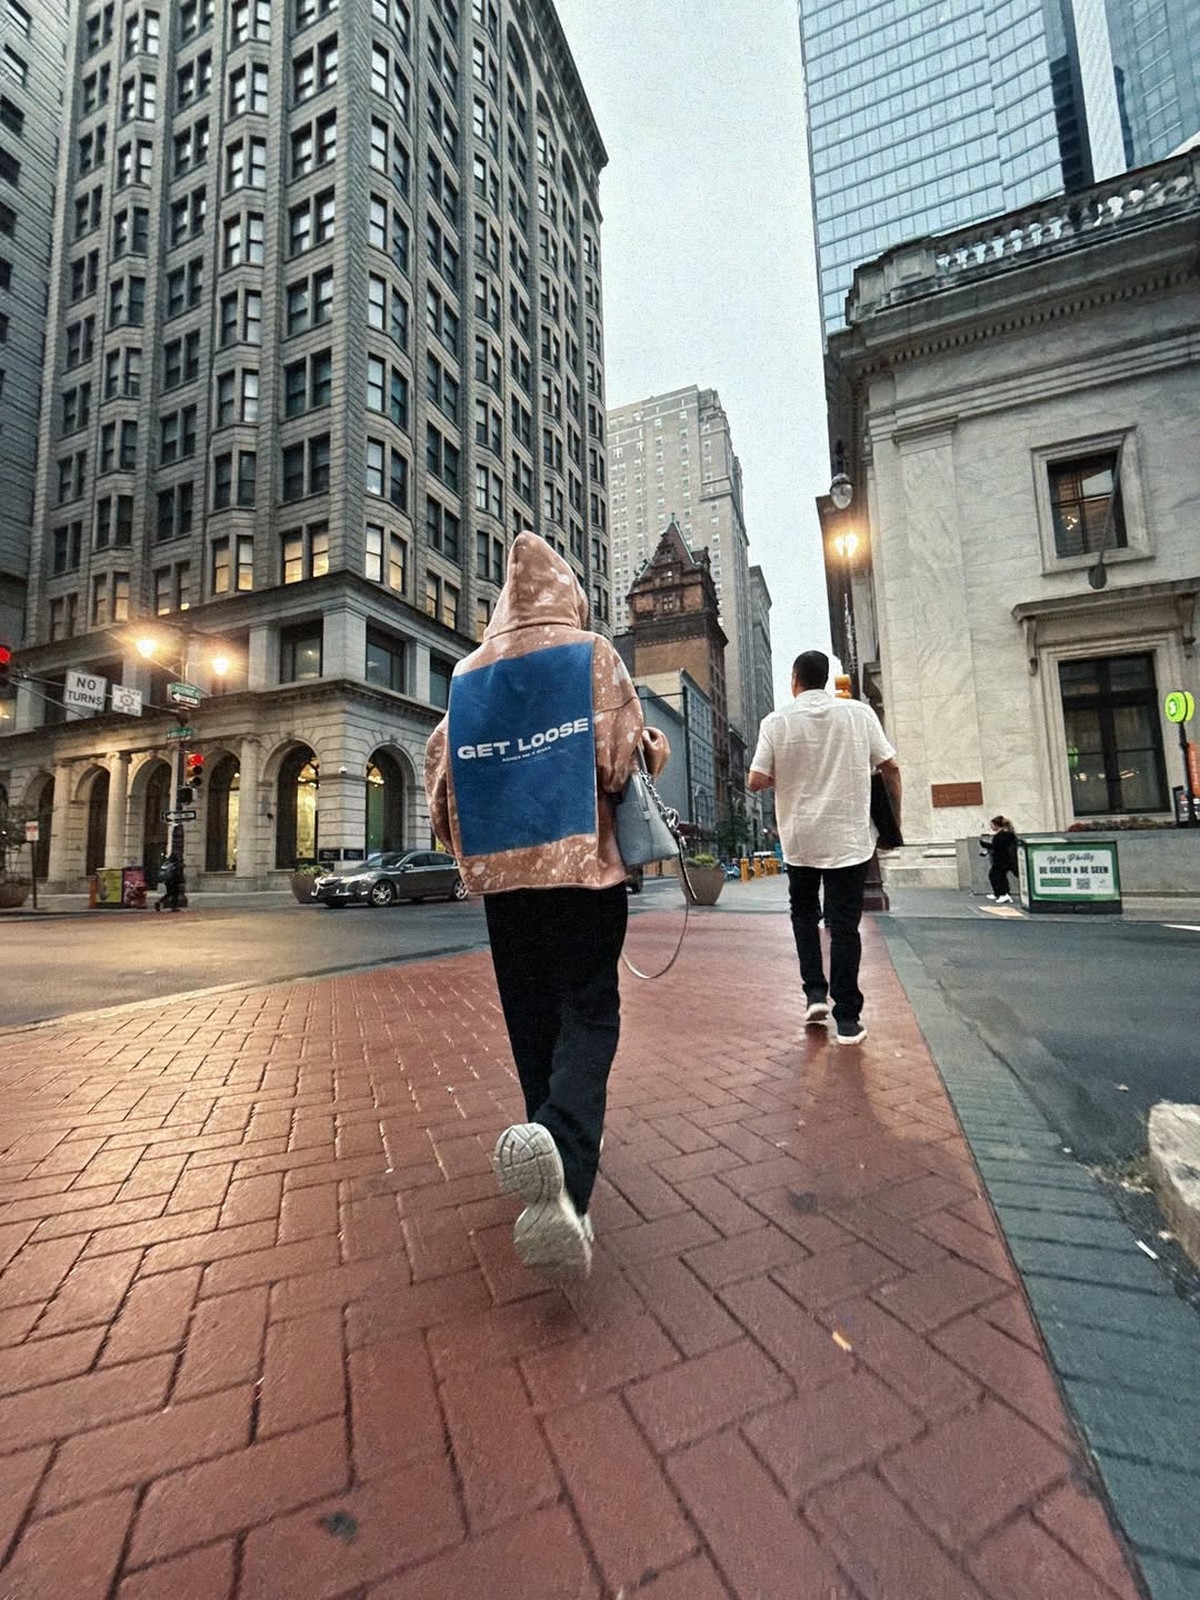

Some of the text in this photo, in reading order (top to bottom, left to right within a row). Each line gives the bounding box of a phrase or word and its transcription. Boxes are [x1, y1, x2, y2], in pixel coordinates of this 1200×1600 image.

[76, 677, 97, 691] NO
[67, 690, 103, 706] TURNS
[457, 740, 510, 760] GET
[517, 717, 589, 752] LOOSE
